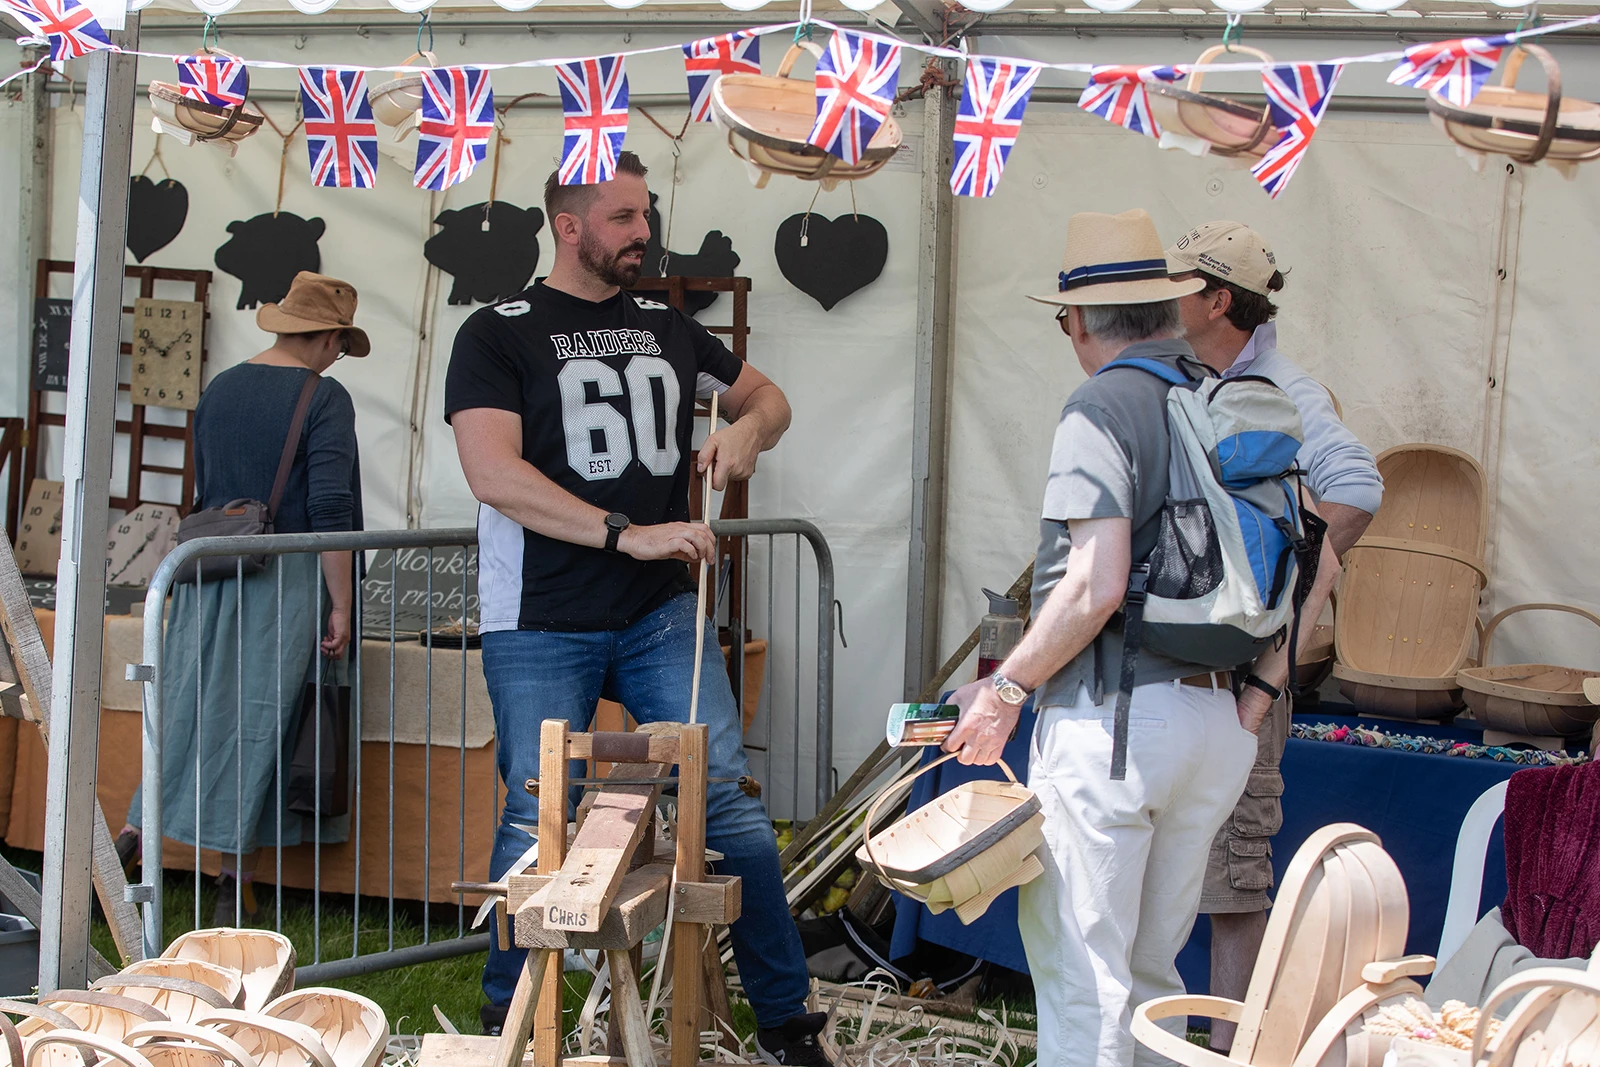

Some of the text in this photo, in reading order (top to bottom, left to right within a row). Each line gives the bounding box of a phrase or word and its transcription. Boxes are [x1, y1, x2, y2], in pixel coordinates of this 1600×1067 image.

[144, 307, 152, 317] 11
[160, 308, 172, 319] 12
[138, 328, 192, 343] 10 2
[550, 329, 662, 359] RAIDERS
[139, 346, 191, 361] 9 3
[138, 363, 190, 378] 8 4
[143, 387, 183, 400] 7 6 5
[557, 355, 681, 482] 60
[589, 460, 615, 474] EST.
[29, 506, 43, 516] 10
[151, 509, 163, 519] 12
[24, 524, 32, 533] 9
[118, 525, 131, 534] 10
[20, 541, 28, 551] 8
[108, 541, 116, 550] 9
[549, 906, 587, 926] CHRIS
